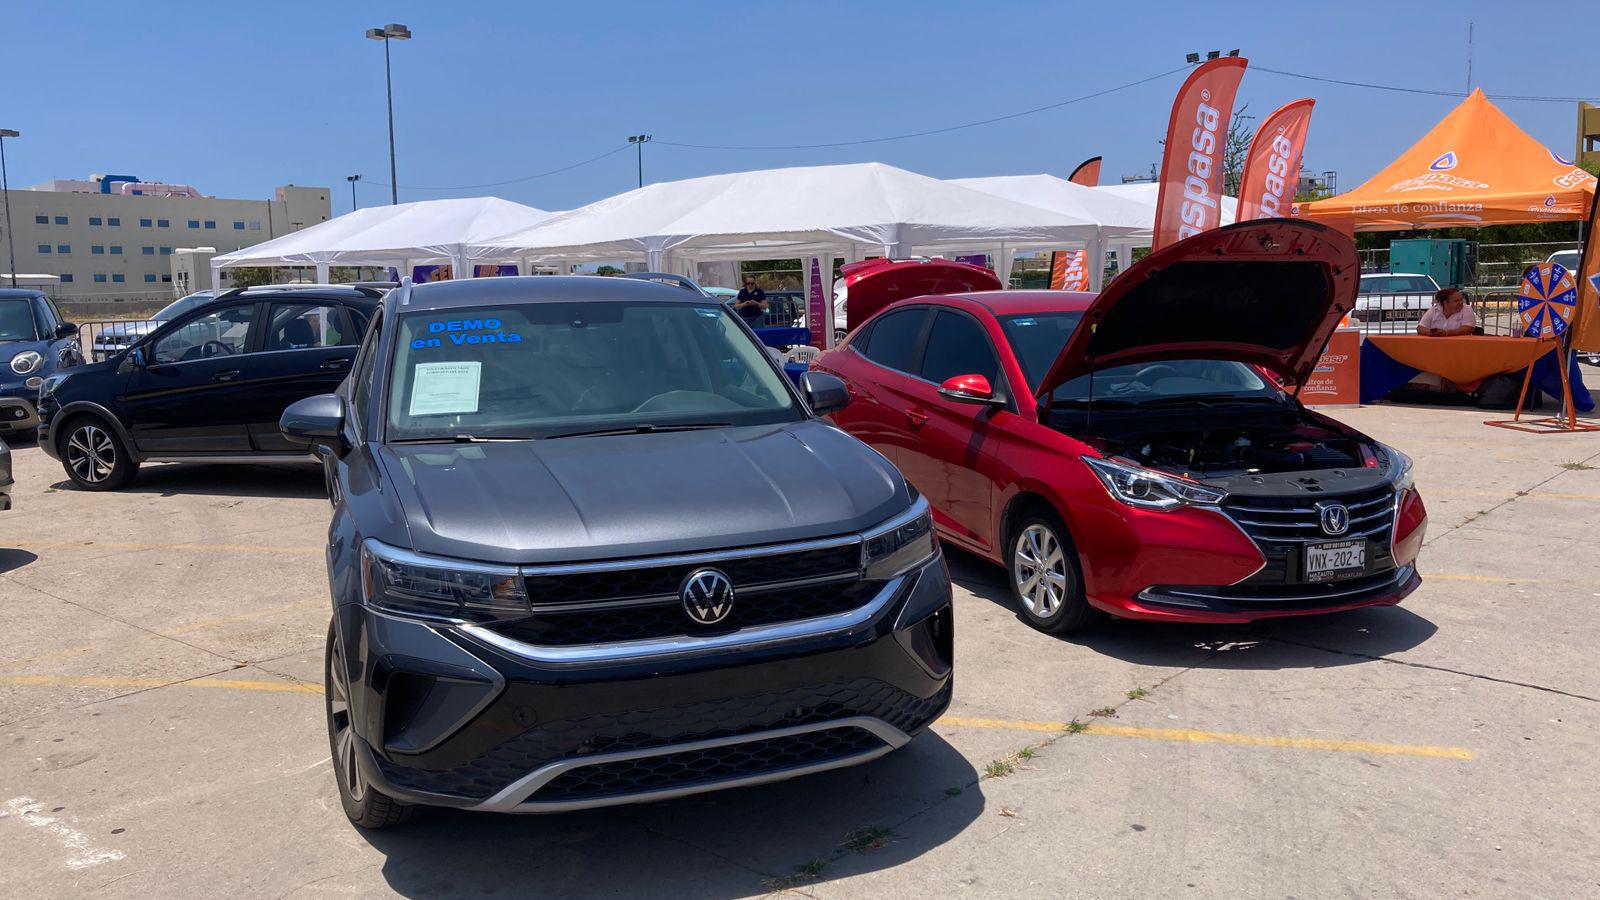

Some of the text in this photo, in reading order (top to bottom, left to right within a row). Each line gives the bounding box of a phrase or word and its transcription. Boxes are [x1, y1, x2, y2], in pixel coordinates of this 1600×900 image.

[1391, 203, 1409, 214] de
[1412, 200, 1483, 213] confianza
[429, 317, 502, 333] DEMO
[411, 330, 522, 350] en Venta
